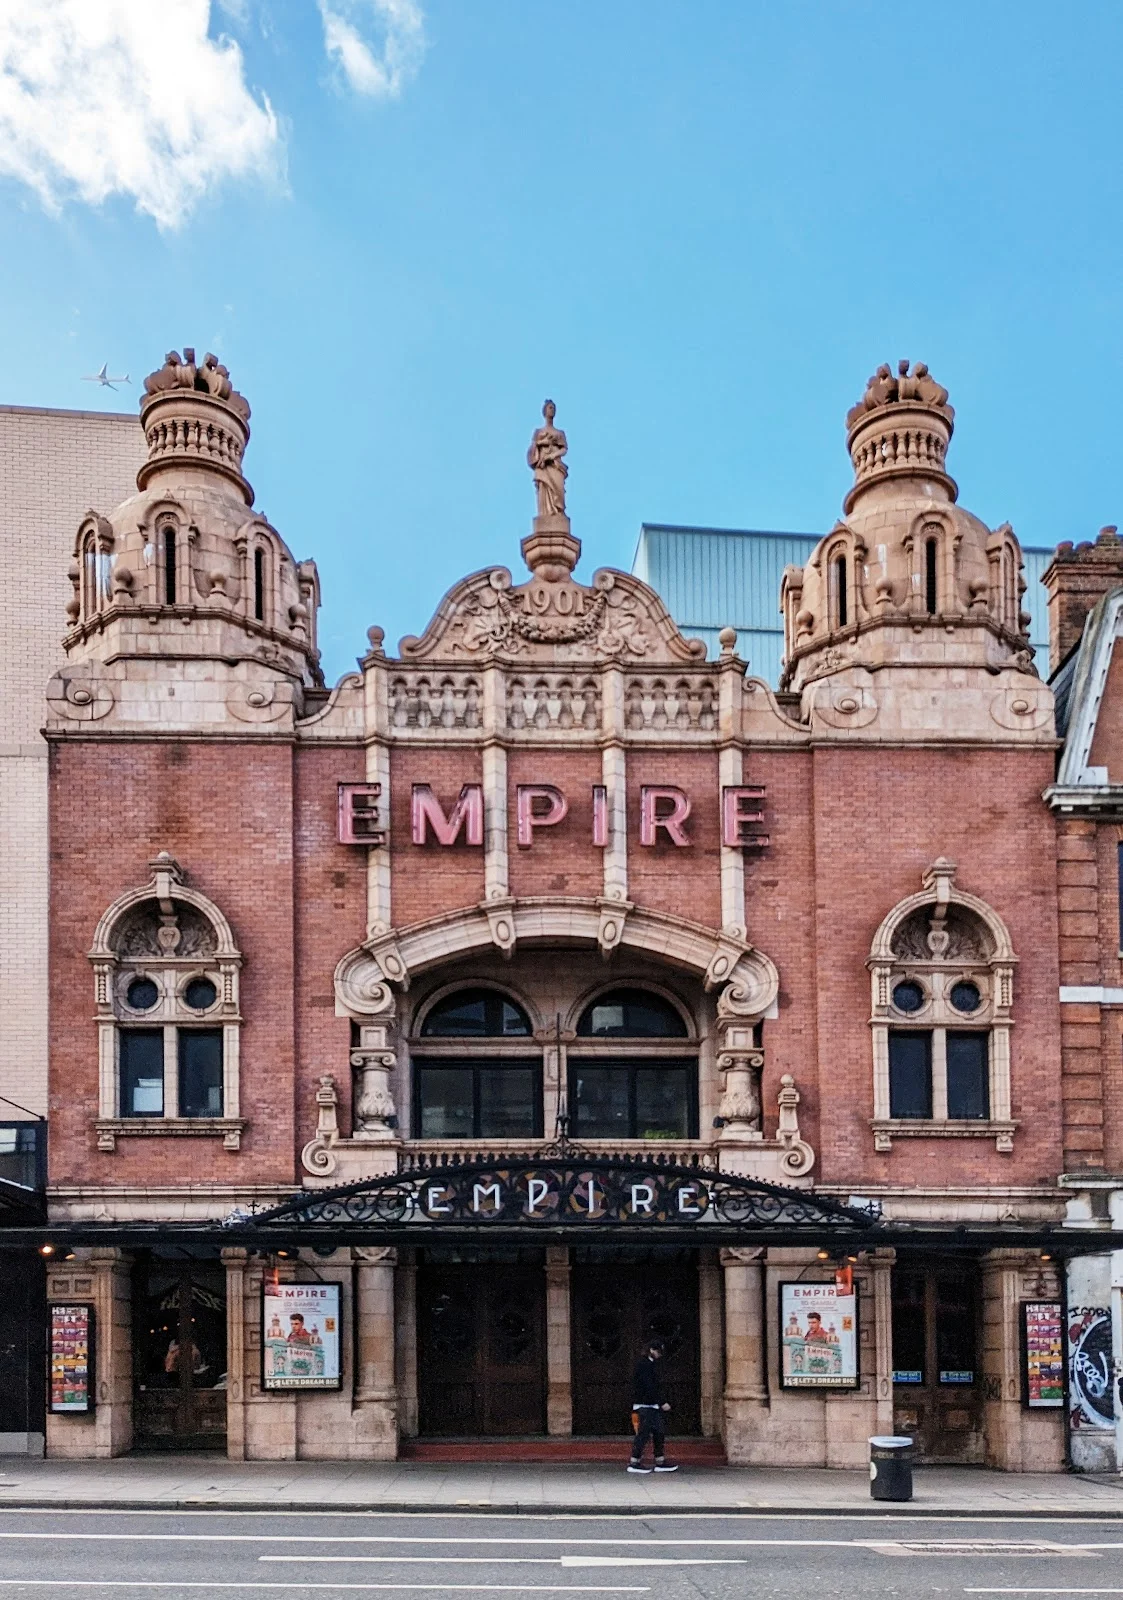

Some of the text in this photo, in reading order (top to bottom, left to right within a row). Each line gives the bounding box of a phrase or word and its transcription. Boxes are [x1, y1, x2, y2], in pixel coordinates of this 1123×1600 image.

[522, 589, 585, 615] 1901
[337, 782, 770, 849] EMPIRE
[428, 1179, 700, 1213] EMPIRE
[277, 1290, 327, 1298] EMPIRE
[794, 1289, 835, 1297] EMPIR
